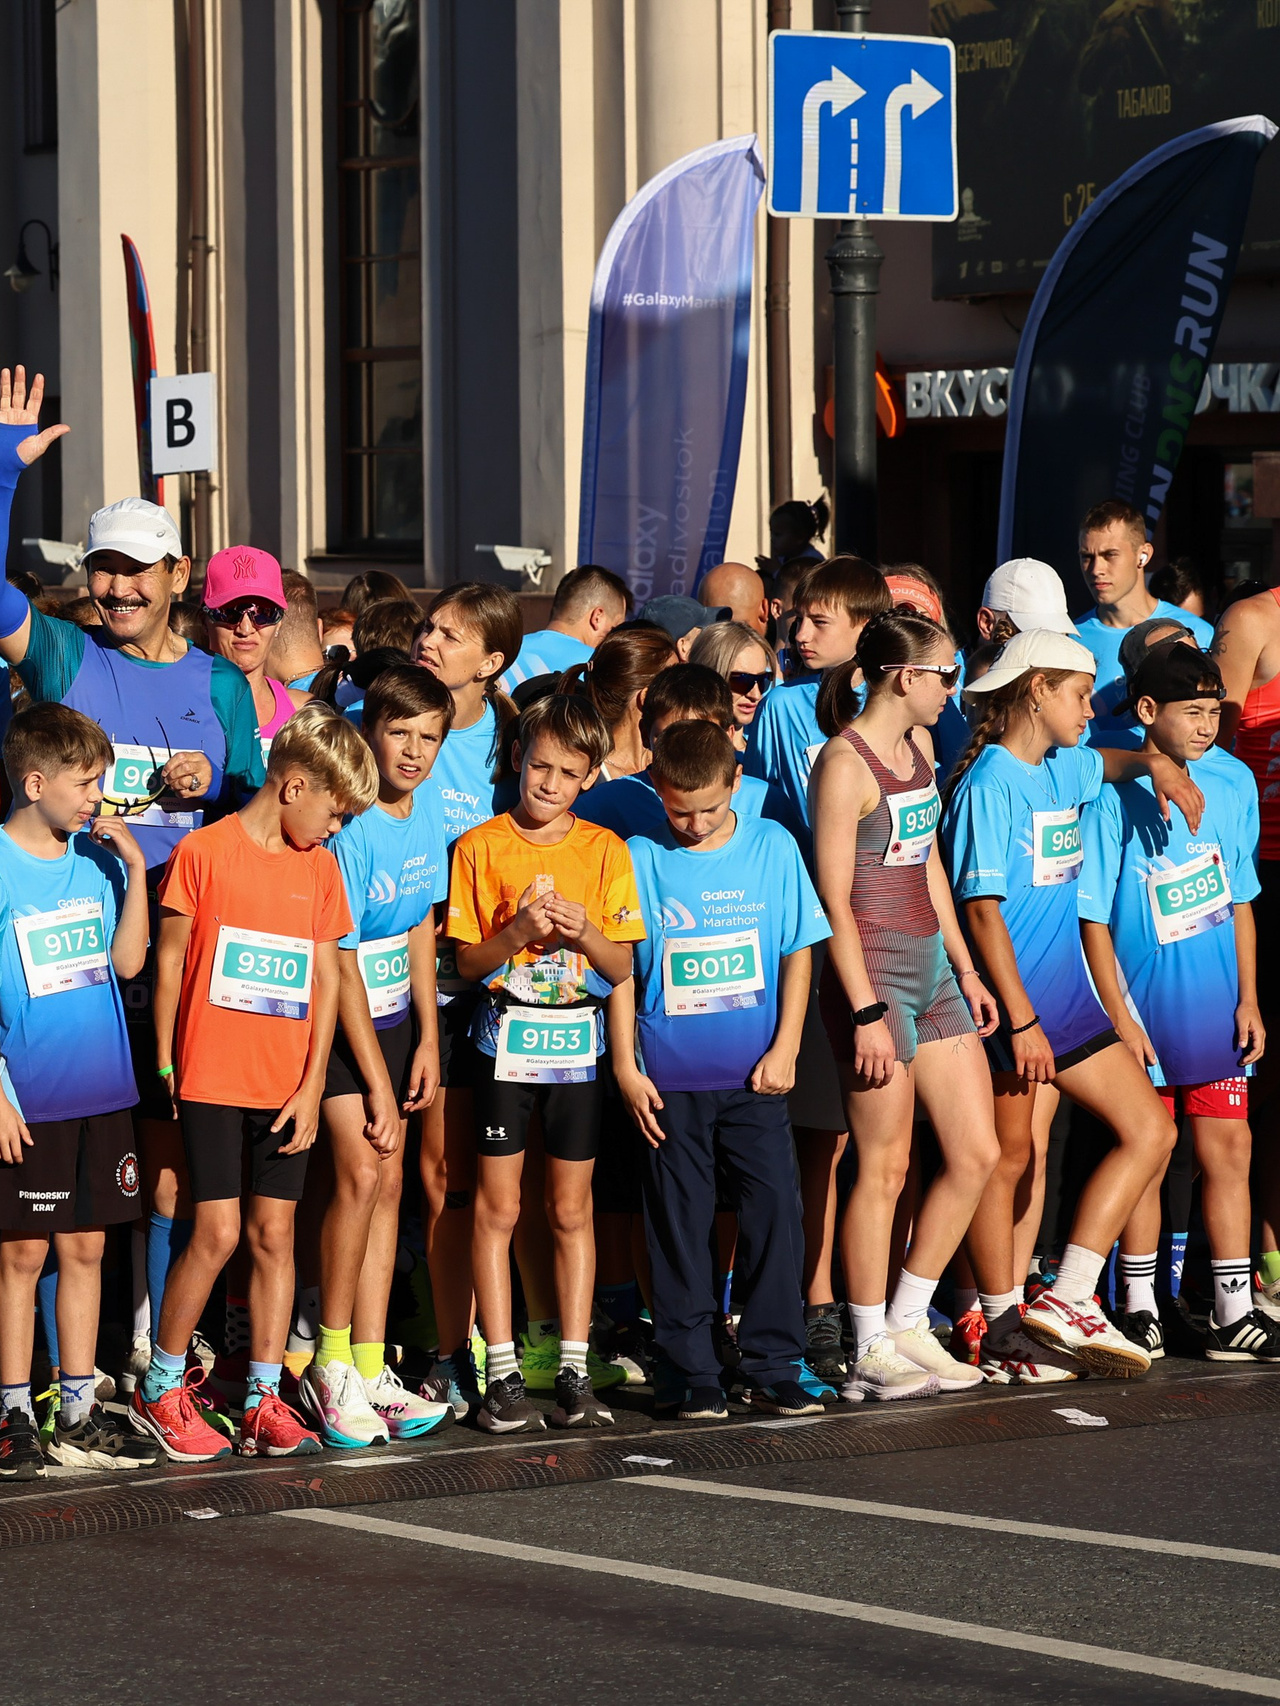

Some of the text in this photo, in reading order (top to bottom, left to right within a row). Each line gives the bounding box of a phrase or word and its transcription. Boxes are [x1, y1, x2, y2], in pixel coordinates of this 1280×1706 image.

[957, 39, 1012, 73] БЕЗРУКОВ
[1117, 84, 1171, 118] ТАБАКОВ
[166, 398, 196, 447] B
[701, 889, 745, 901] Galaxy
[1167, 871, 1218, 908] 9595
[44, 925, 98, 956] 9173
[237, 951, 298, 980] 9310
[682, 954, 746, 980] 9012
[240, 984, 289, 996] #GalaxyMarathon
[692, 984, 742, 994] #GalaxyMarathon
[522, 1028, 581, 1050] 9153
[19, 1190, 71, 1200] PRIMORSKIY
[32, 1203, 56, 1212] KRAY
